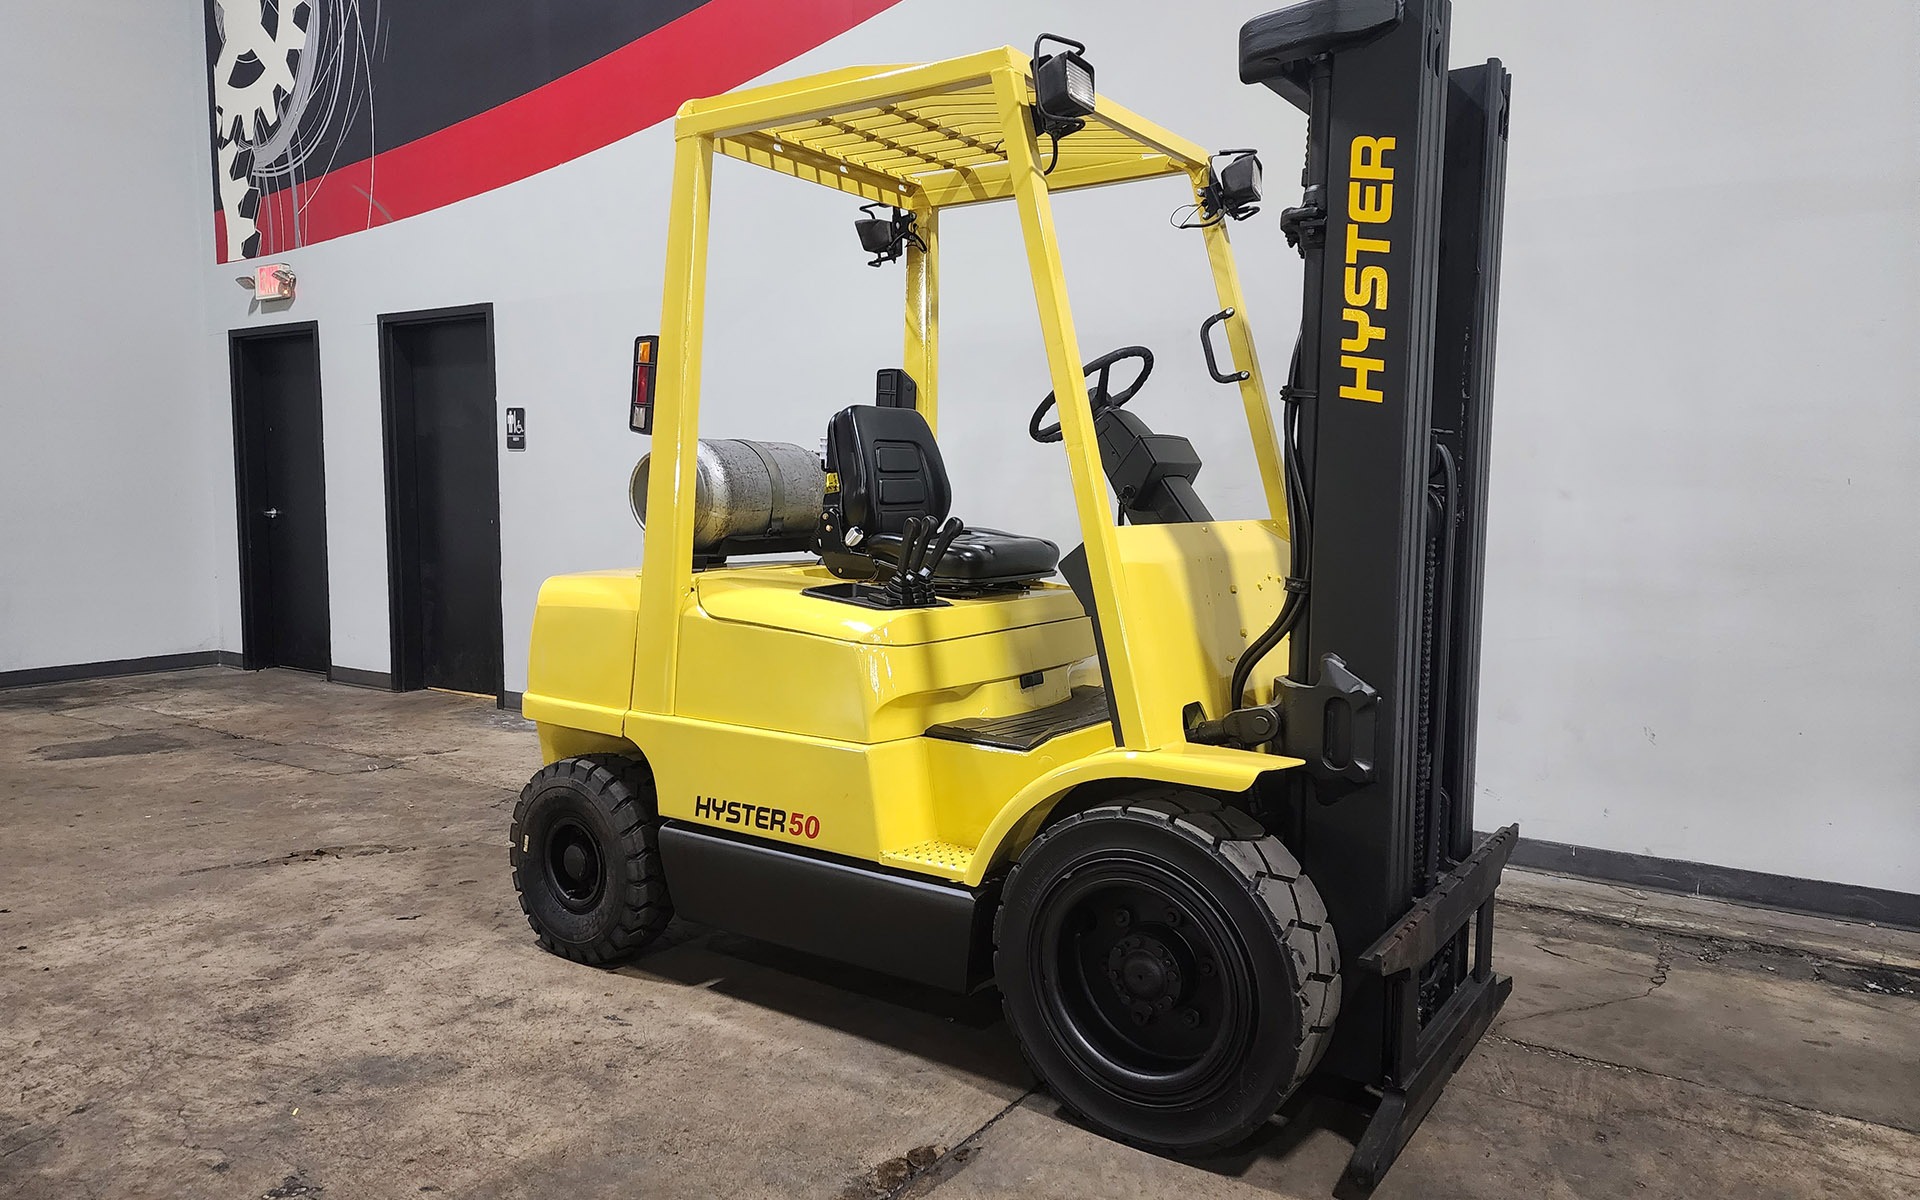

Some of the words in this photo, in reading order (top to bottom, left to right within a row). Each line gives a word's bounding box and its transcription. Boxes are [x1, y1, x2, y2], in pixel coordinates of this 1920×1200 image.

[1339, 135, 1396, 403] HYSTER
[695, 795, 786, 832] HYSTER
[788, 812, 820, 839] 50
